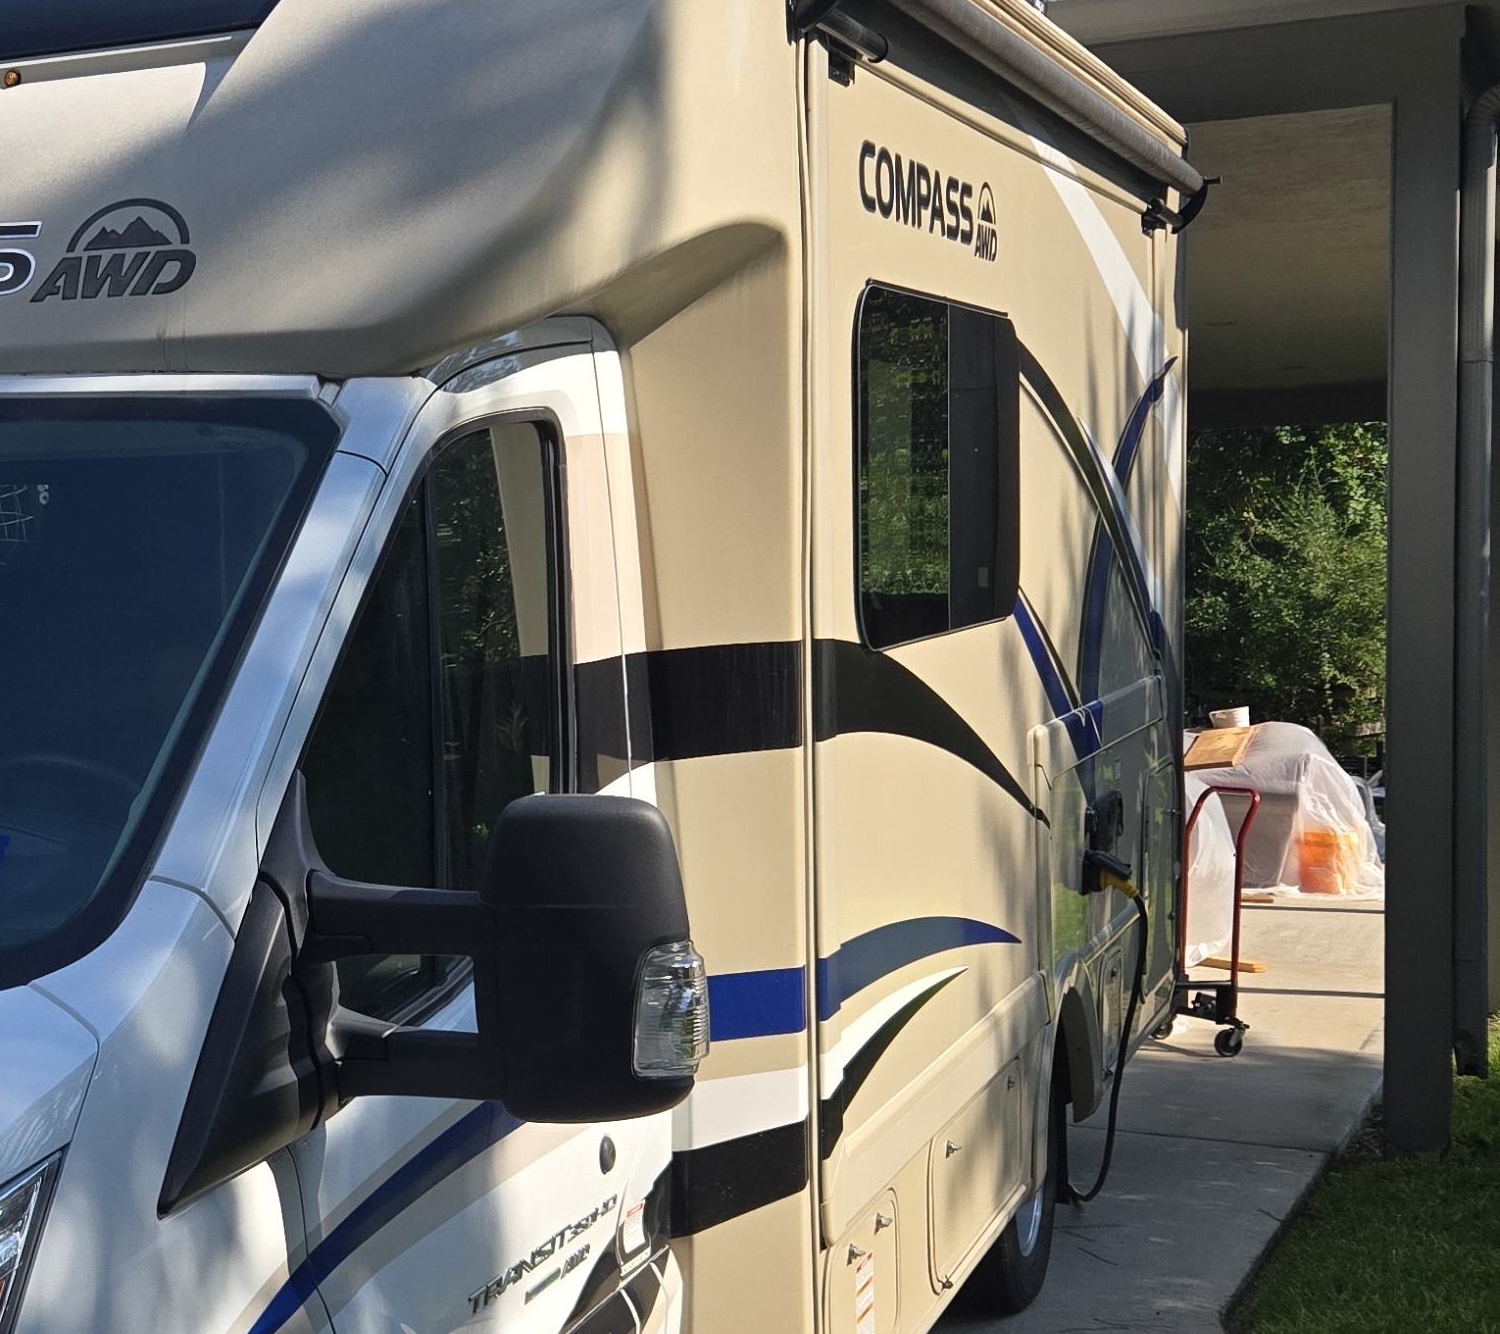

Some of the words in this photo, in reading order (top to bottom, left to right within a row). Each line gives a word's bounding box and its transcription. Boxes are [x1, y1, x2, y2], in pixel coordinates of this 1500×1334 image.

[858, 139, 974, 245] COMPASS
[974, 224, 998, 262] AWD
[30, 248, 197, 304] AWD
